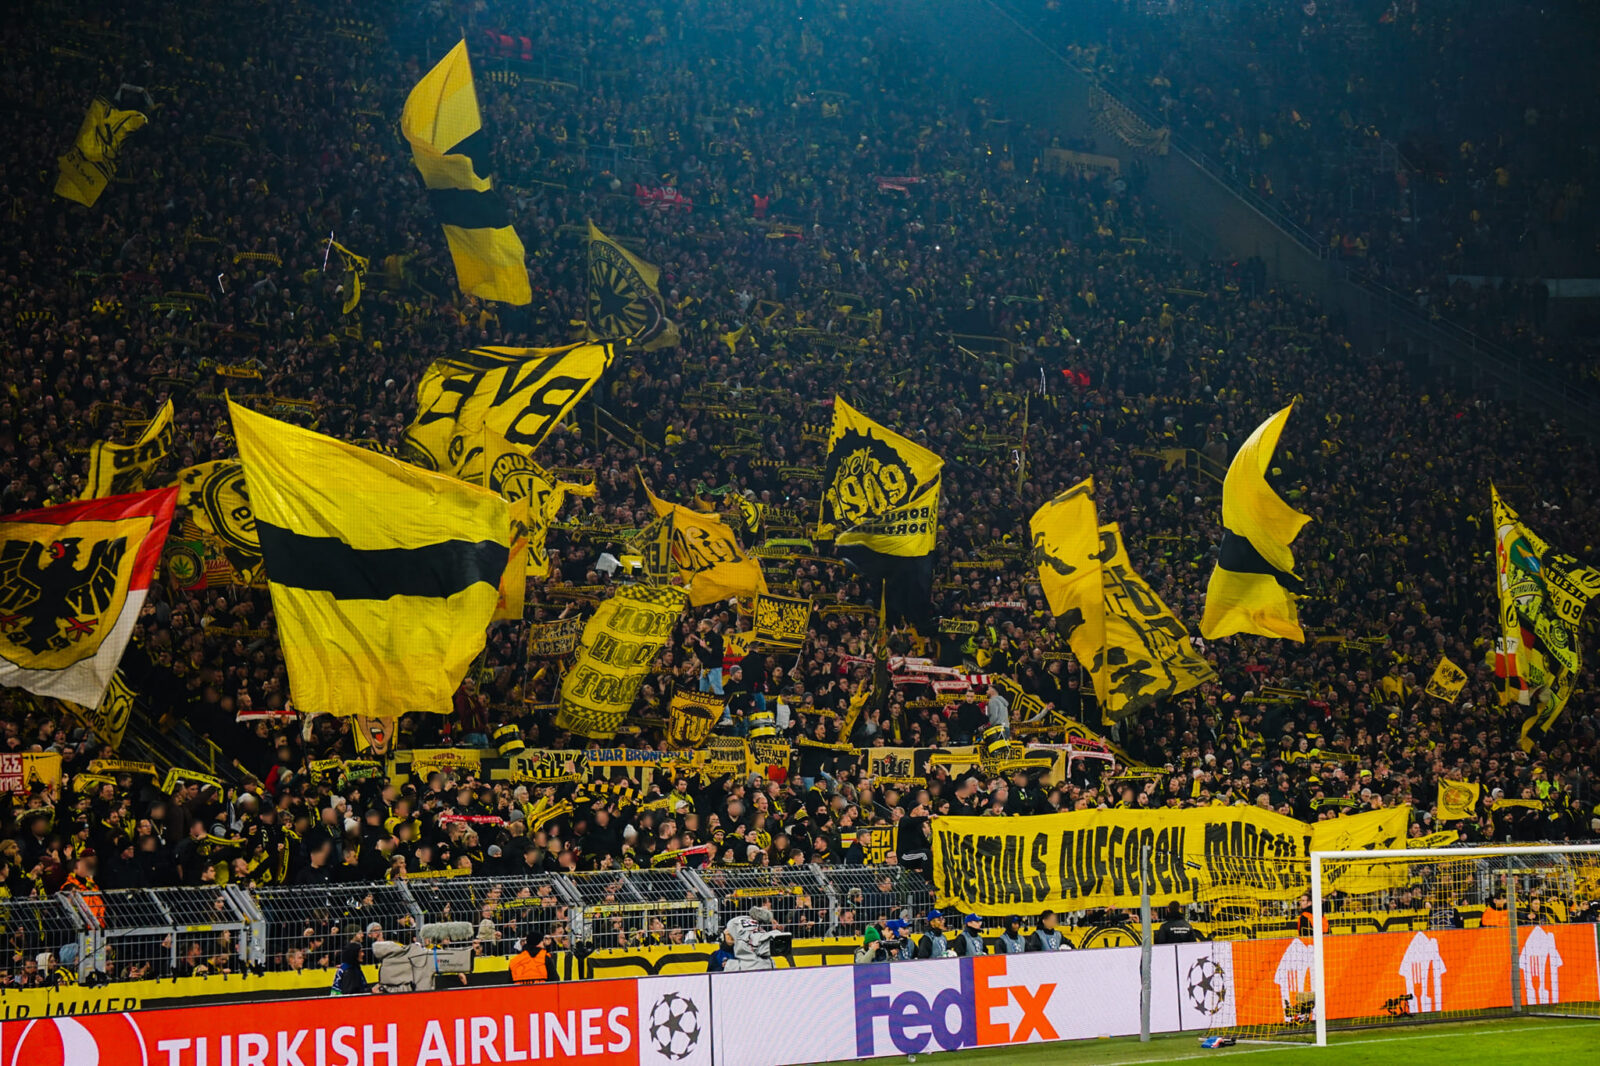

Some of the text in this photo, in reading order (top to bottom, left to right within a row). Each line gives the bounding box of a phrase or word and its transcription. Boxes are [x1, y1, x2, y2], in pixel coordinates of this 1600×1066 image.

[1562, 599, 1582, 620] 09
[157, 1006, 632, 1066] TURKISH AIRLINES
[854, 955, 1060, 1057] FedEx
